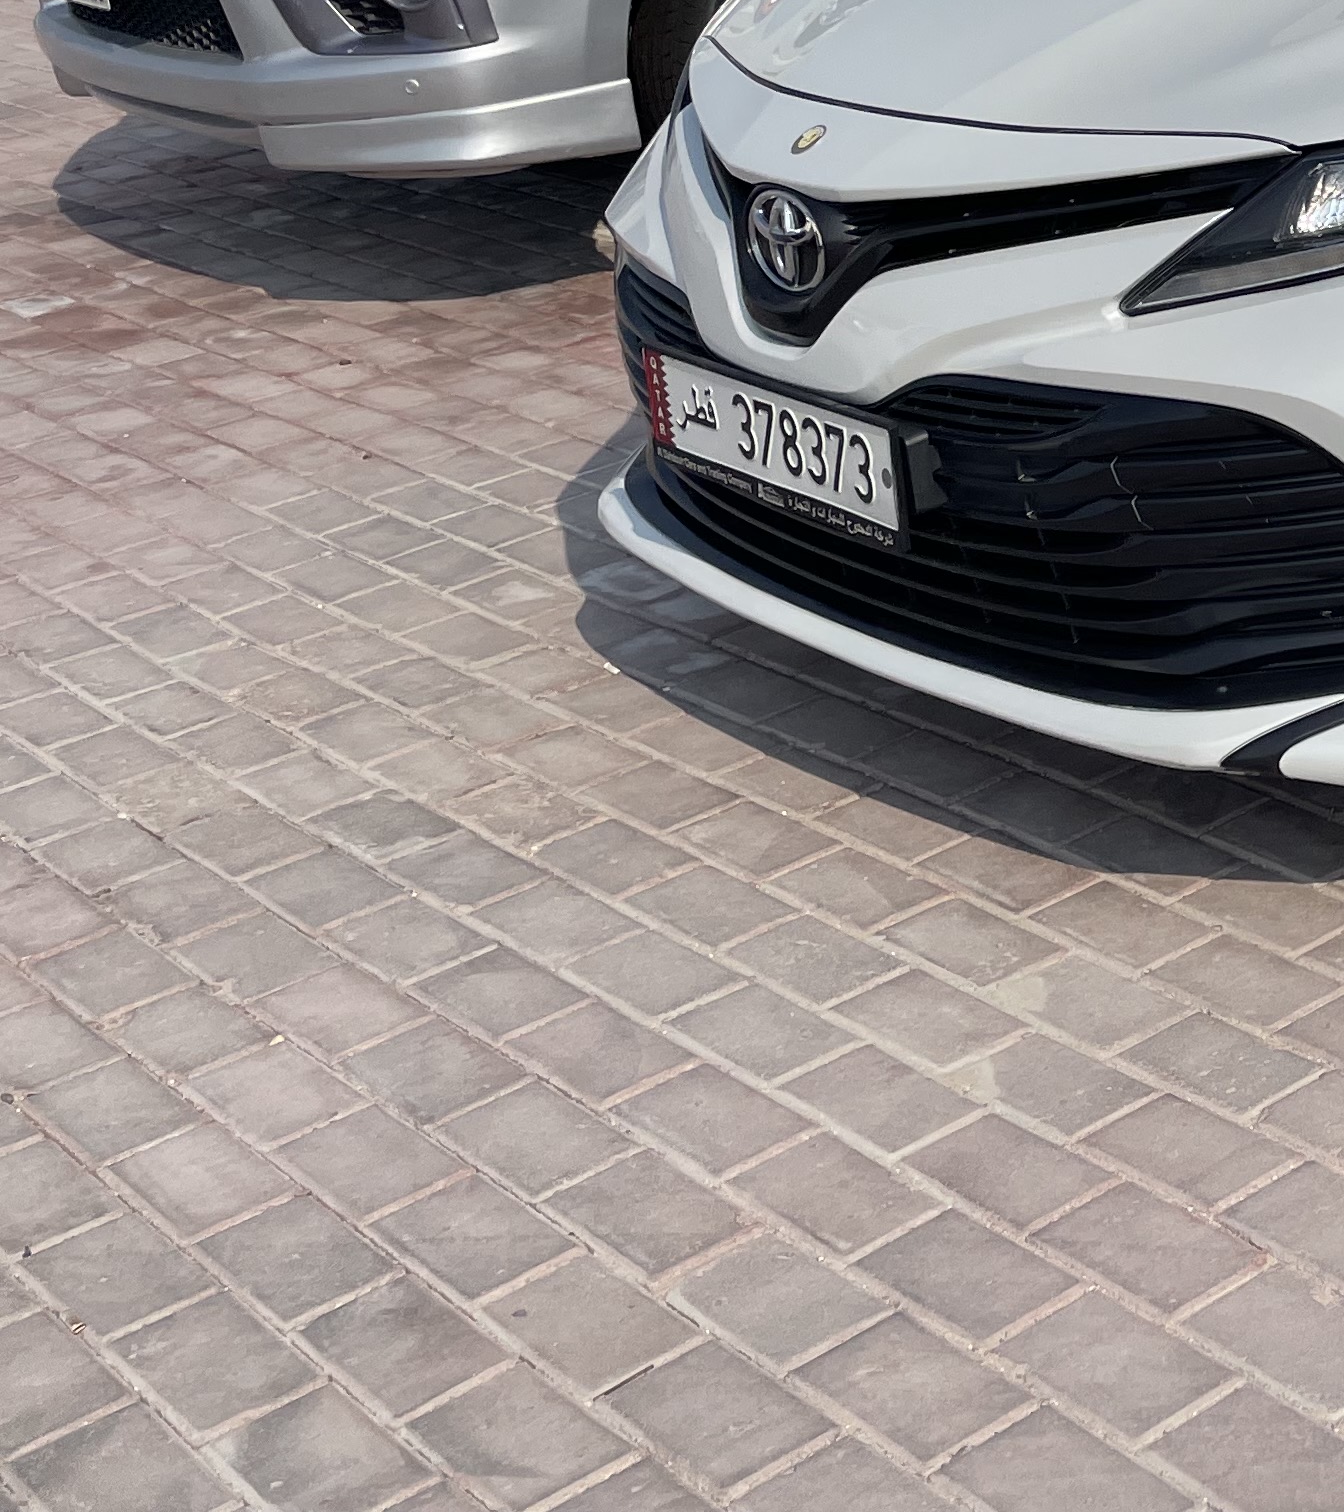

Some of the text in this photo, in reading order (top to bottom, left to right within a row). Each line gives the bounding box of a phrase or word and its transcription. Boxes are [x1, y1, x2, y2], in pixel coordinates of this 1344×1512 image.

[648, 355, 667, 437] QATAR
[675, 383, 720, 431] قطر
[731, 392, 876, 505] 378373
